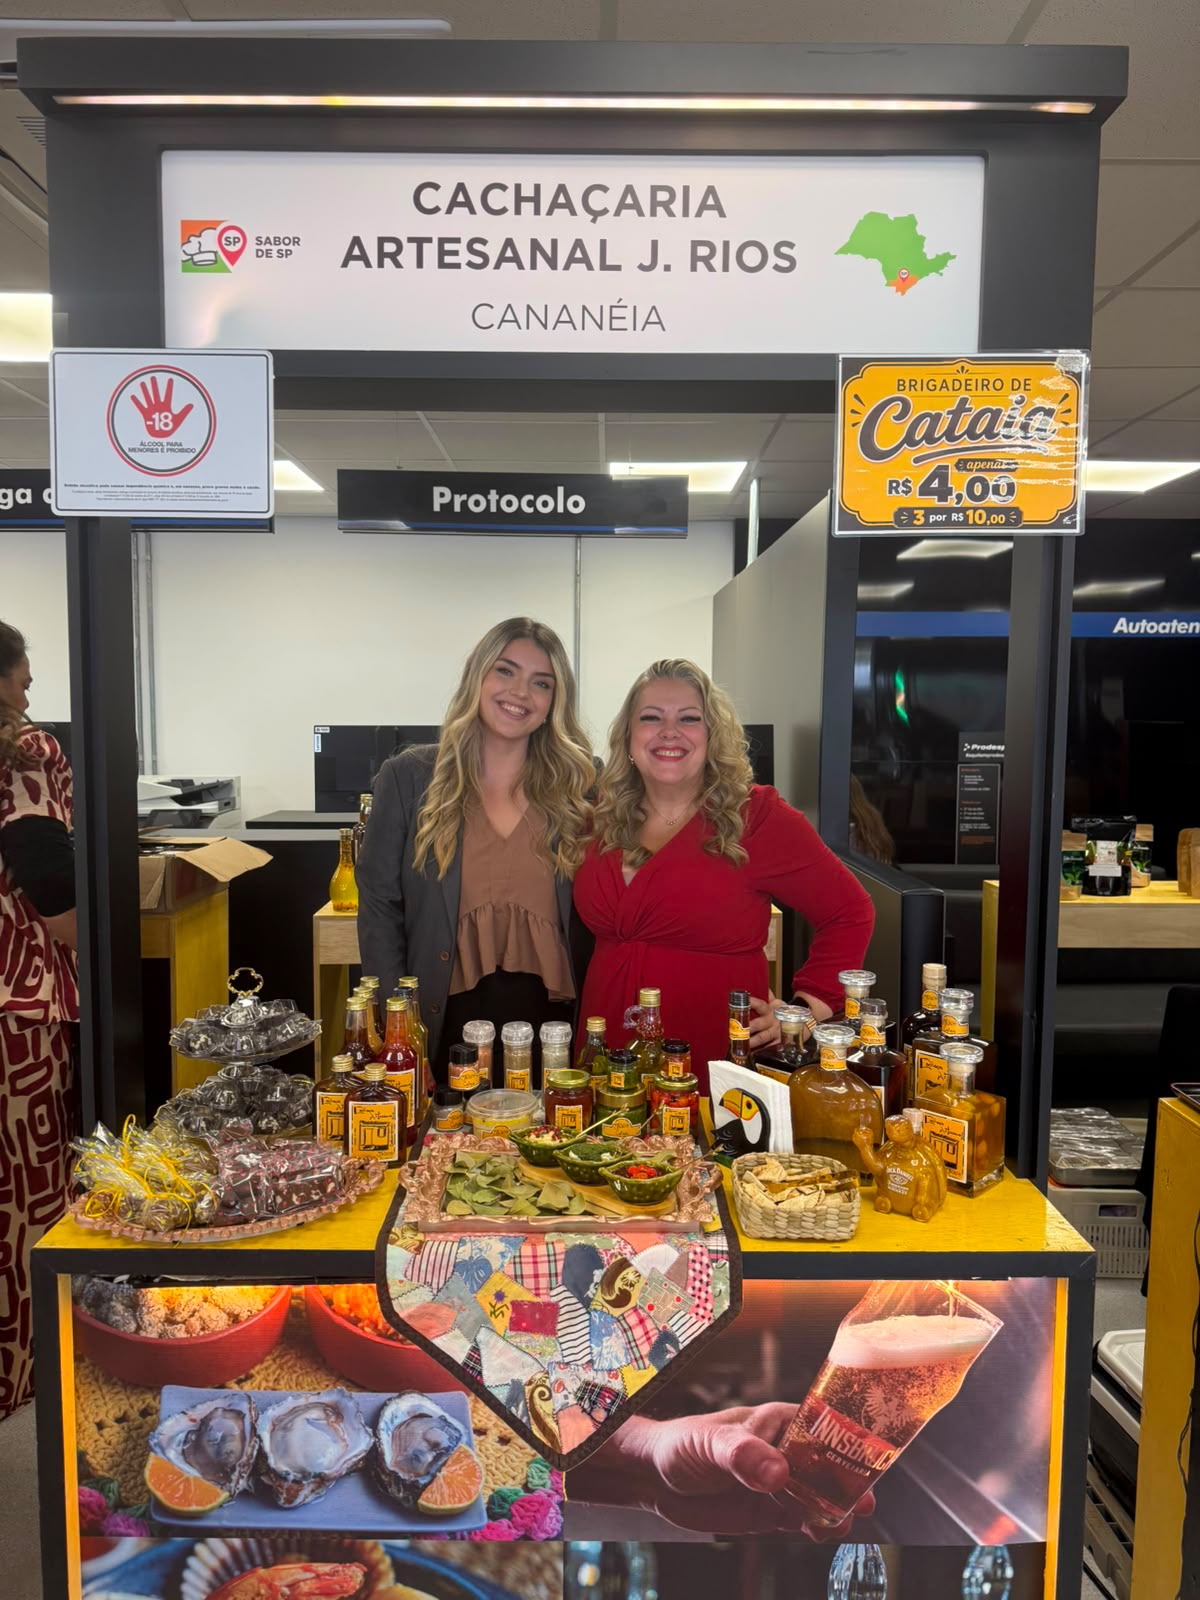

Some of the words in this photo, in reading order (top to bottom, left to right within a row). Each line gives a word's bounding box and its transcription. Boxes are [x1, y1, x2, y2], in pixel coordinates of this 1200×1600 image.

[412, 181, 727, 224] CACHAÇARIA
[223, 236, 241, 247] SP
[255, 236, 301, 247] SABOR
[255, 248, 273, 259] DE
[276, 248, 293, 259] SP
[340, 235, 622, 272] ARTESANAL
[636, 238, 672, 273] J.
[689, 239, 798, 274] RIOS
[471, 297, 667, 332] CANANÉIA
[896, 377, 1005, 392] BRIGADEIRO
[1010, 378, 1032, 392] DE
[146, 411, 173, 432] -18
[858, 393, 1058, 463] Cataia
[139, 439, 164, 447] ÁLCOOL
[887, 477, 913, 497] R$
[917, 464, 1017, 507] 4,00
[432, 485, 586, 514] Protocolo
[912, 509, 926, 526] 3
[929, 513, 947, 523] por
[965, 509, 1006, 526] 10,00
